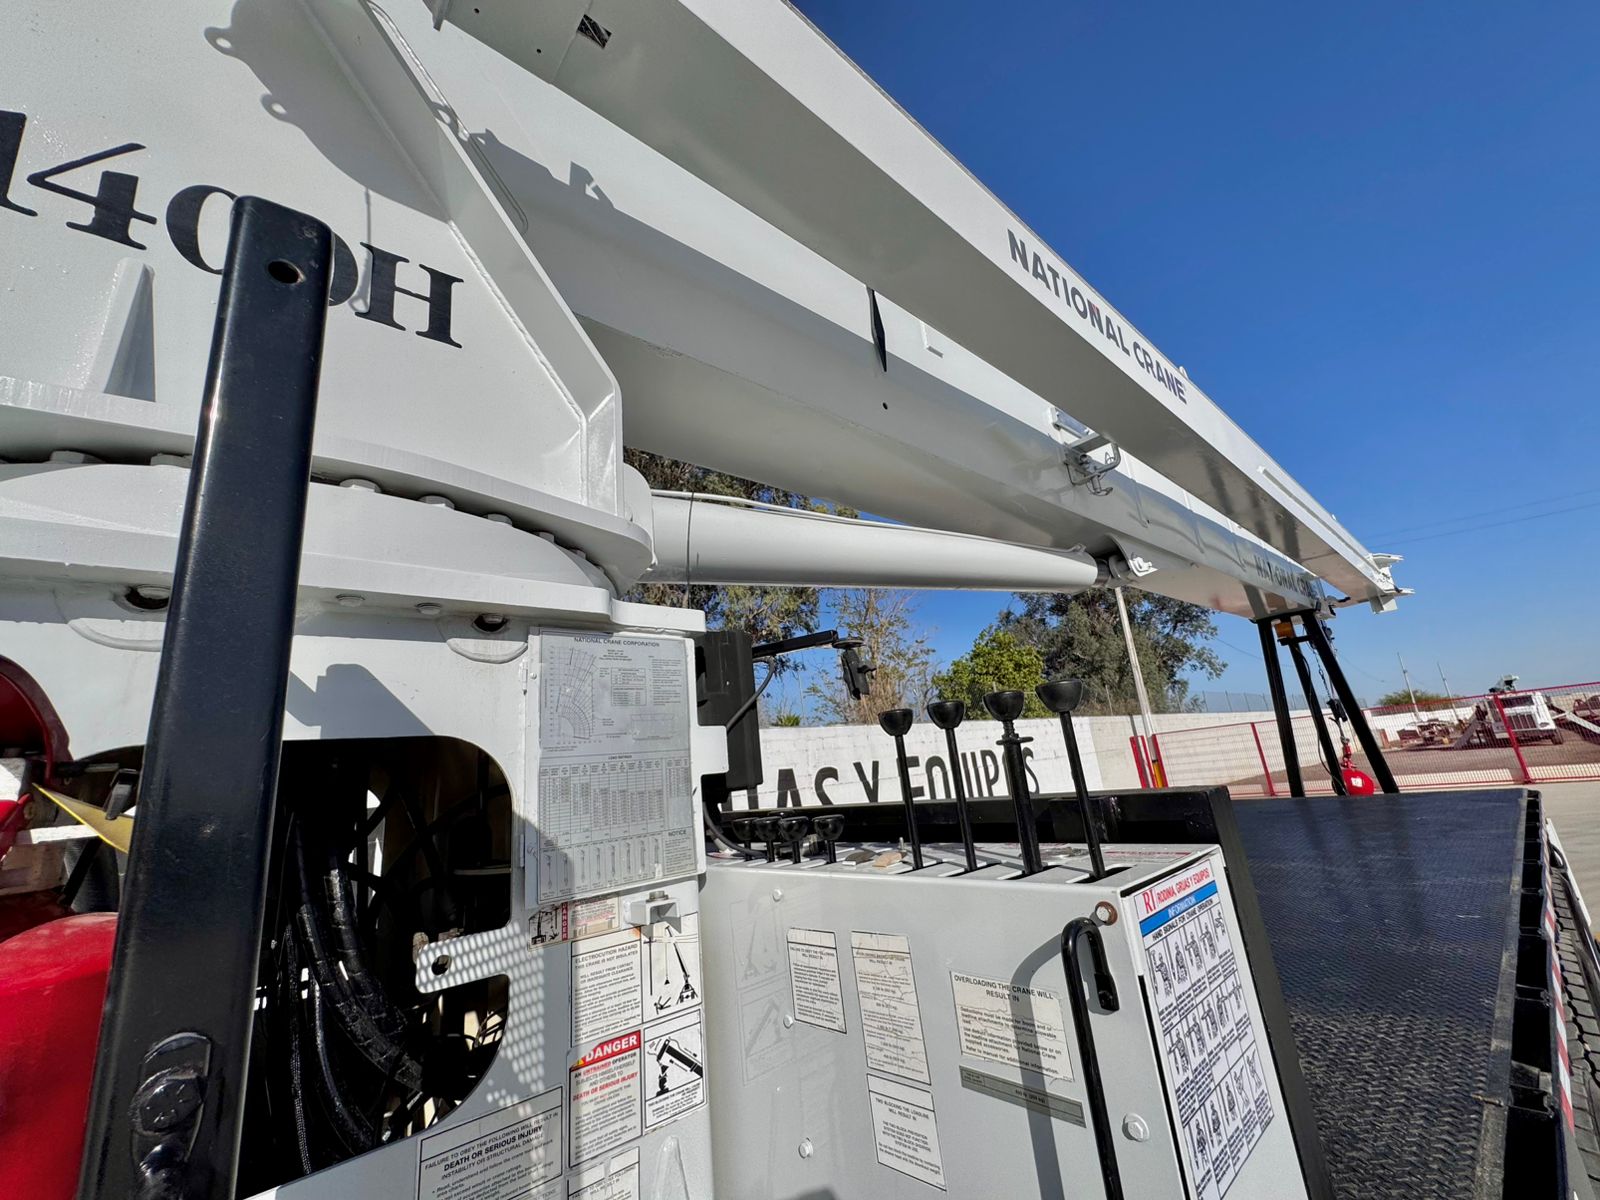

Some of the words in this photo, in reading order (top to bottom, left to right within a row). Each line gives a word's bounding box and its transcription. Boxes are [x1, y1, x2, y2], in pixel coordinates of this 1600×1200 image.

[0, 110, 463, 348] 140H
[1007, 228, 1131, 357] NATIONAL
[1132, 341, 1187, 405] CRANE
[574, 636, 602, 645] NATIONAL
[853, 760, 880, 803] Y
[897, 747, 1040, 801] EQIPS
[954, 975, 997, 989] OVERLOADING
[998, 983, 1011, 992] THE
[1012, 985, 1036, 997] CRANE
[1037, 990, 1053, 1000] WILL
[985, 990, 1010, 1001] RESULT
[586, 1035, 637, 1061] DANGER
[611, 1051, 636, 1064] OPERATOR
[572, 1089, 589, 1101] DEATH
[590, 1086, 597, 1094] OR
[598, 1078, 619, 1091] SERIOUS
[620, 1071, 637, 1082] INJURY
[425, 1156, 448, 1170] FAILURE
[450, 1151, 458, 1159] TO
[460, 1145, 475, 1155] OBEY
[476, 1140, 487, 1149] THE
[488, 1127, 519, 1144] FOLLOWING
[520, 1121, 533, 1130] WILL
[441, 1160, 475, 1180] INSTABILITY
[476, 1156, 485, 1165] OR
[486, 1141, 521, 1161] STRUCTURAL
[444, 1154, 469, 1171] DEATH
[471, 1148, 483, 1159] OR
[484, 1135, 516, 1154] SERIOUS
[517, 1124, 542, 1140] INJURY
